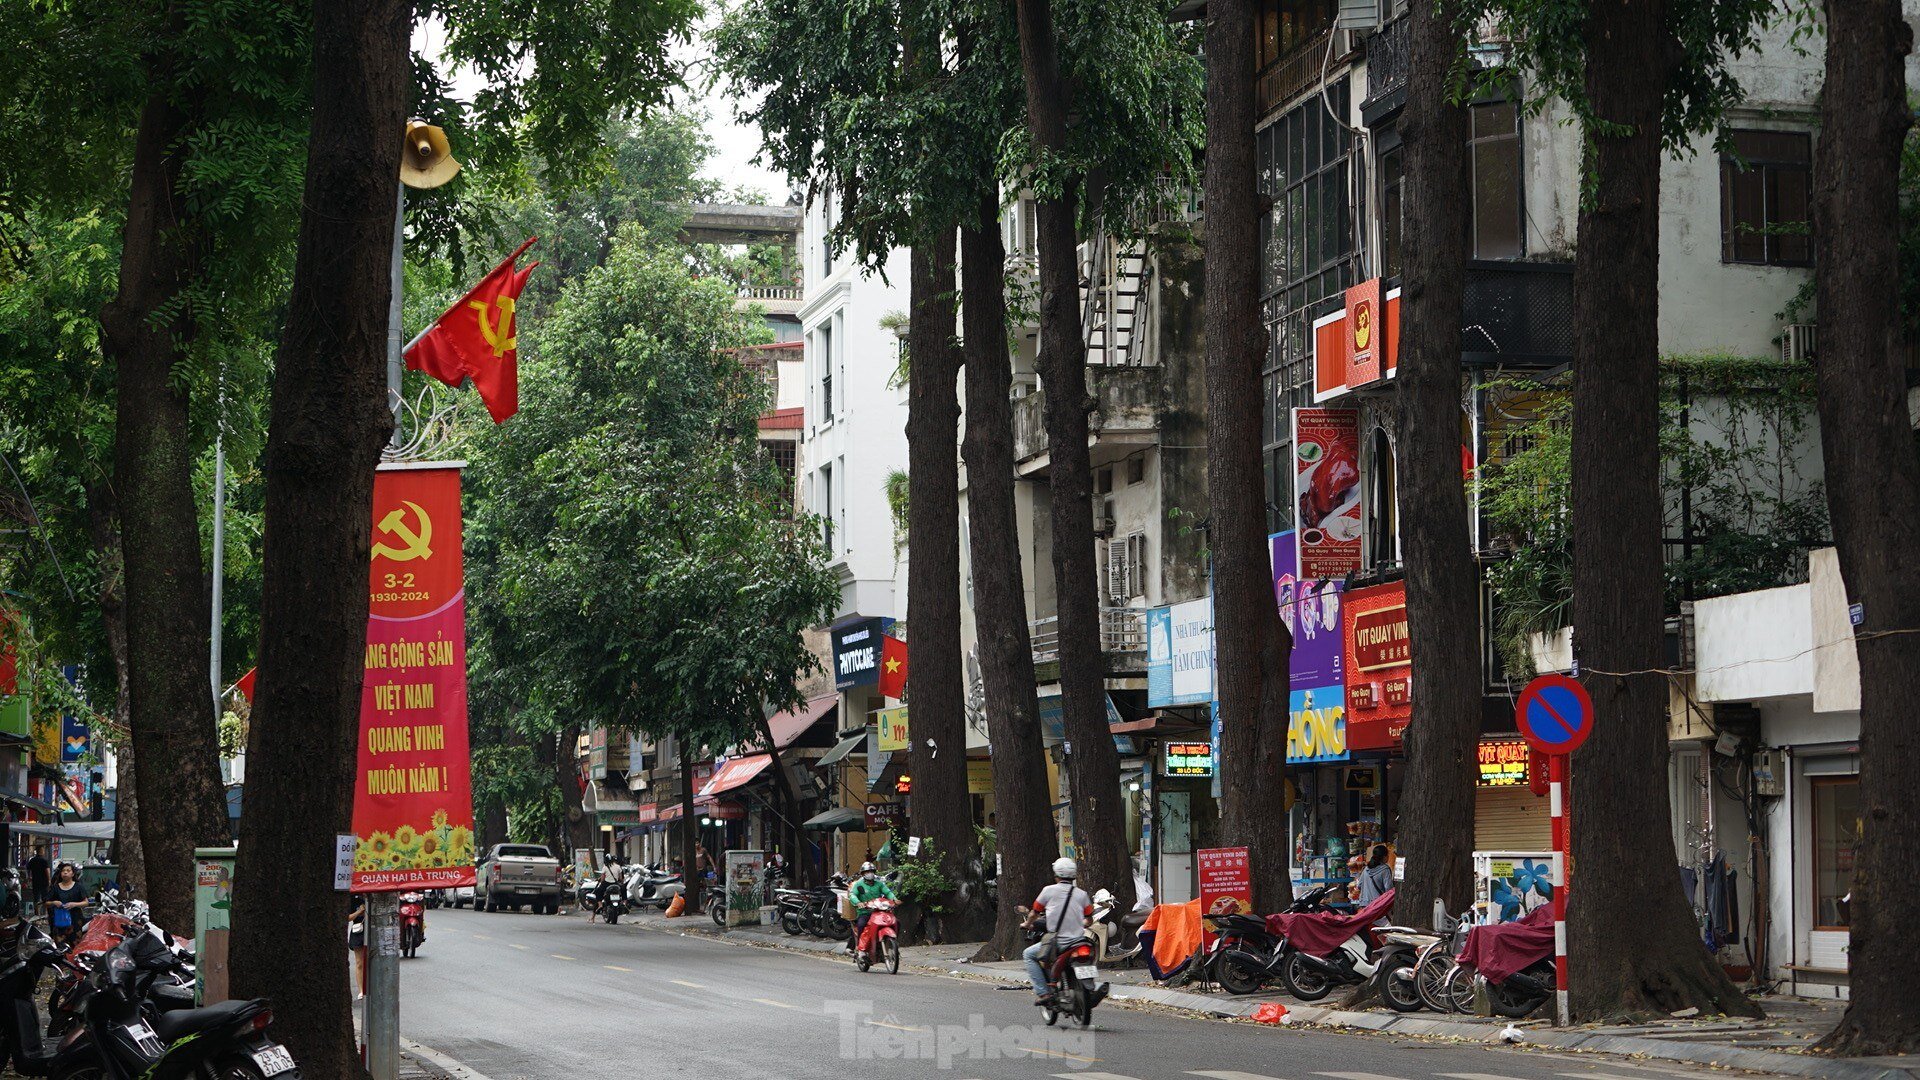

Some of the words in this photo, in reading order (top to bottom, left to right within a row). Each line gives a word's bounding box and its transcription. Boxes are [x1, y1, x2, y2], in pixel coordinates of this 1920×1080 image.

[384, 573, 415, 588] 3-2
[370, 592, 430, 602] 1930-2024
[1175, 620, 1188, 639] NHÀ
[1357, 628, 1369, 651] VỊT
[1370, 624, 1391, 645] QUAY
[390, 638, 425, 673] CỘNG
[428, 630, 454, 668] SẢN
[839, 646, 875, 675] PHYTOCARE
[375, 680, 401, 715] VIỆT
[404, 684, 434, 709] NAM
[368, 726, 411, 755] QUANG
[414, 725, 444, 750] VINH
[1479, 745, 1496, 764] VỊT
[1497, 744, 1526, 765] QUAY
[368, 764, 406, 794] MUÔN
[409, 762, 439, 794] NĂM
[443, 766, 448, 791] !
[866, 805, 899, 816] CAFE
[361, 874, 389, 885] QUẬN
[392, 873, 407, 882] HAI
[410, 870, 423, 881] BÀ
[426, 869, 461, 880] TRƯNG
